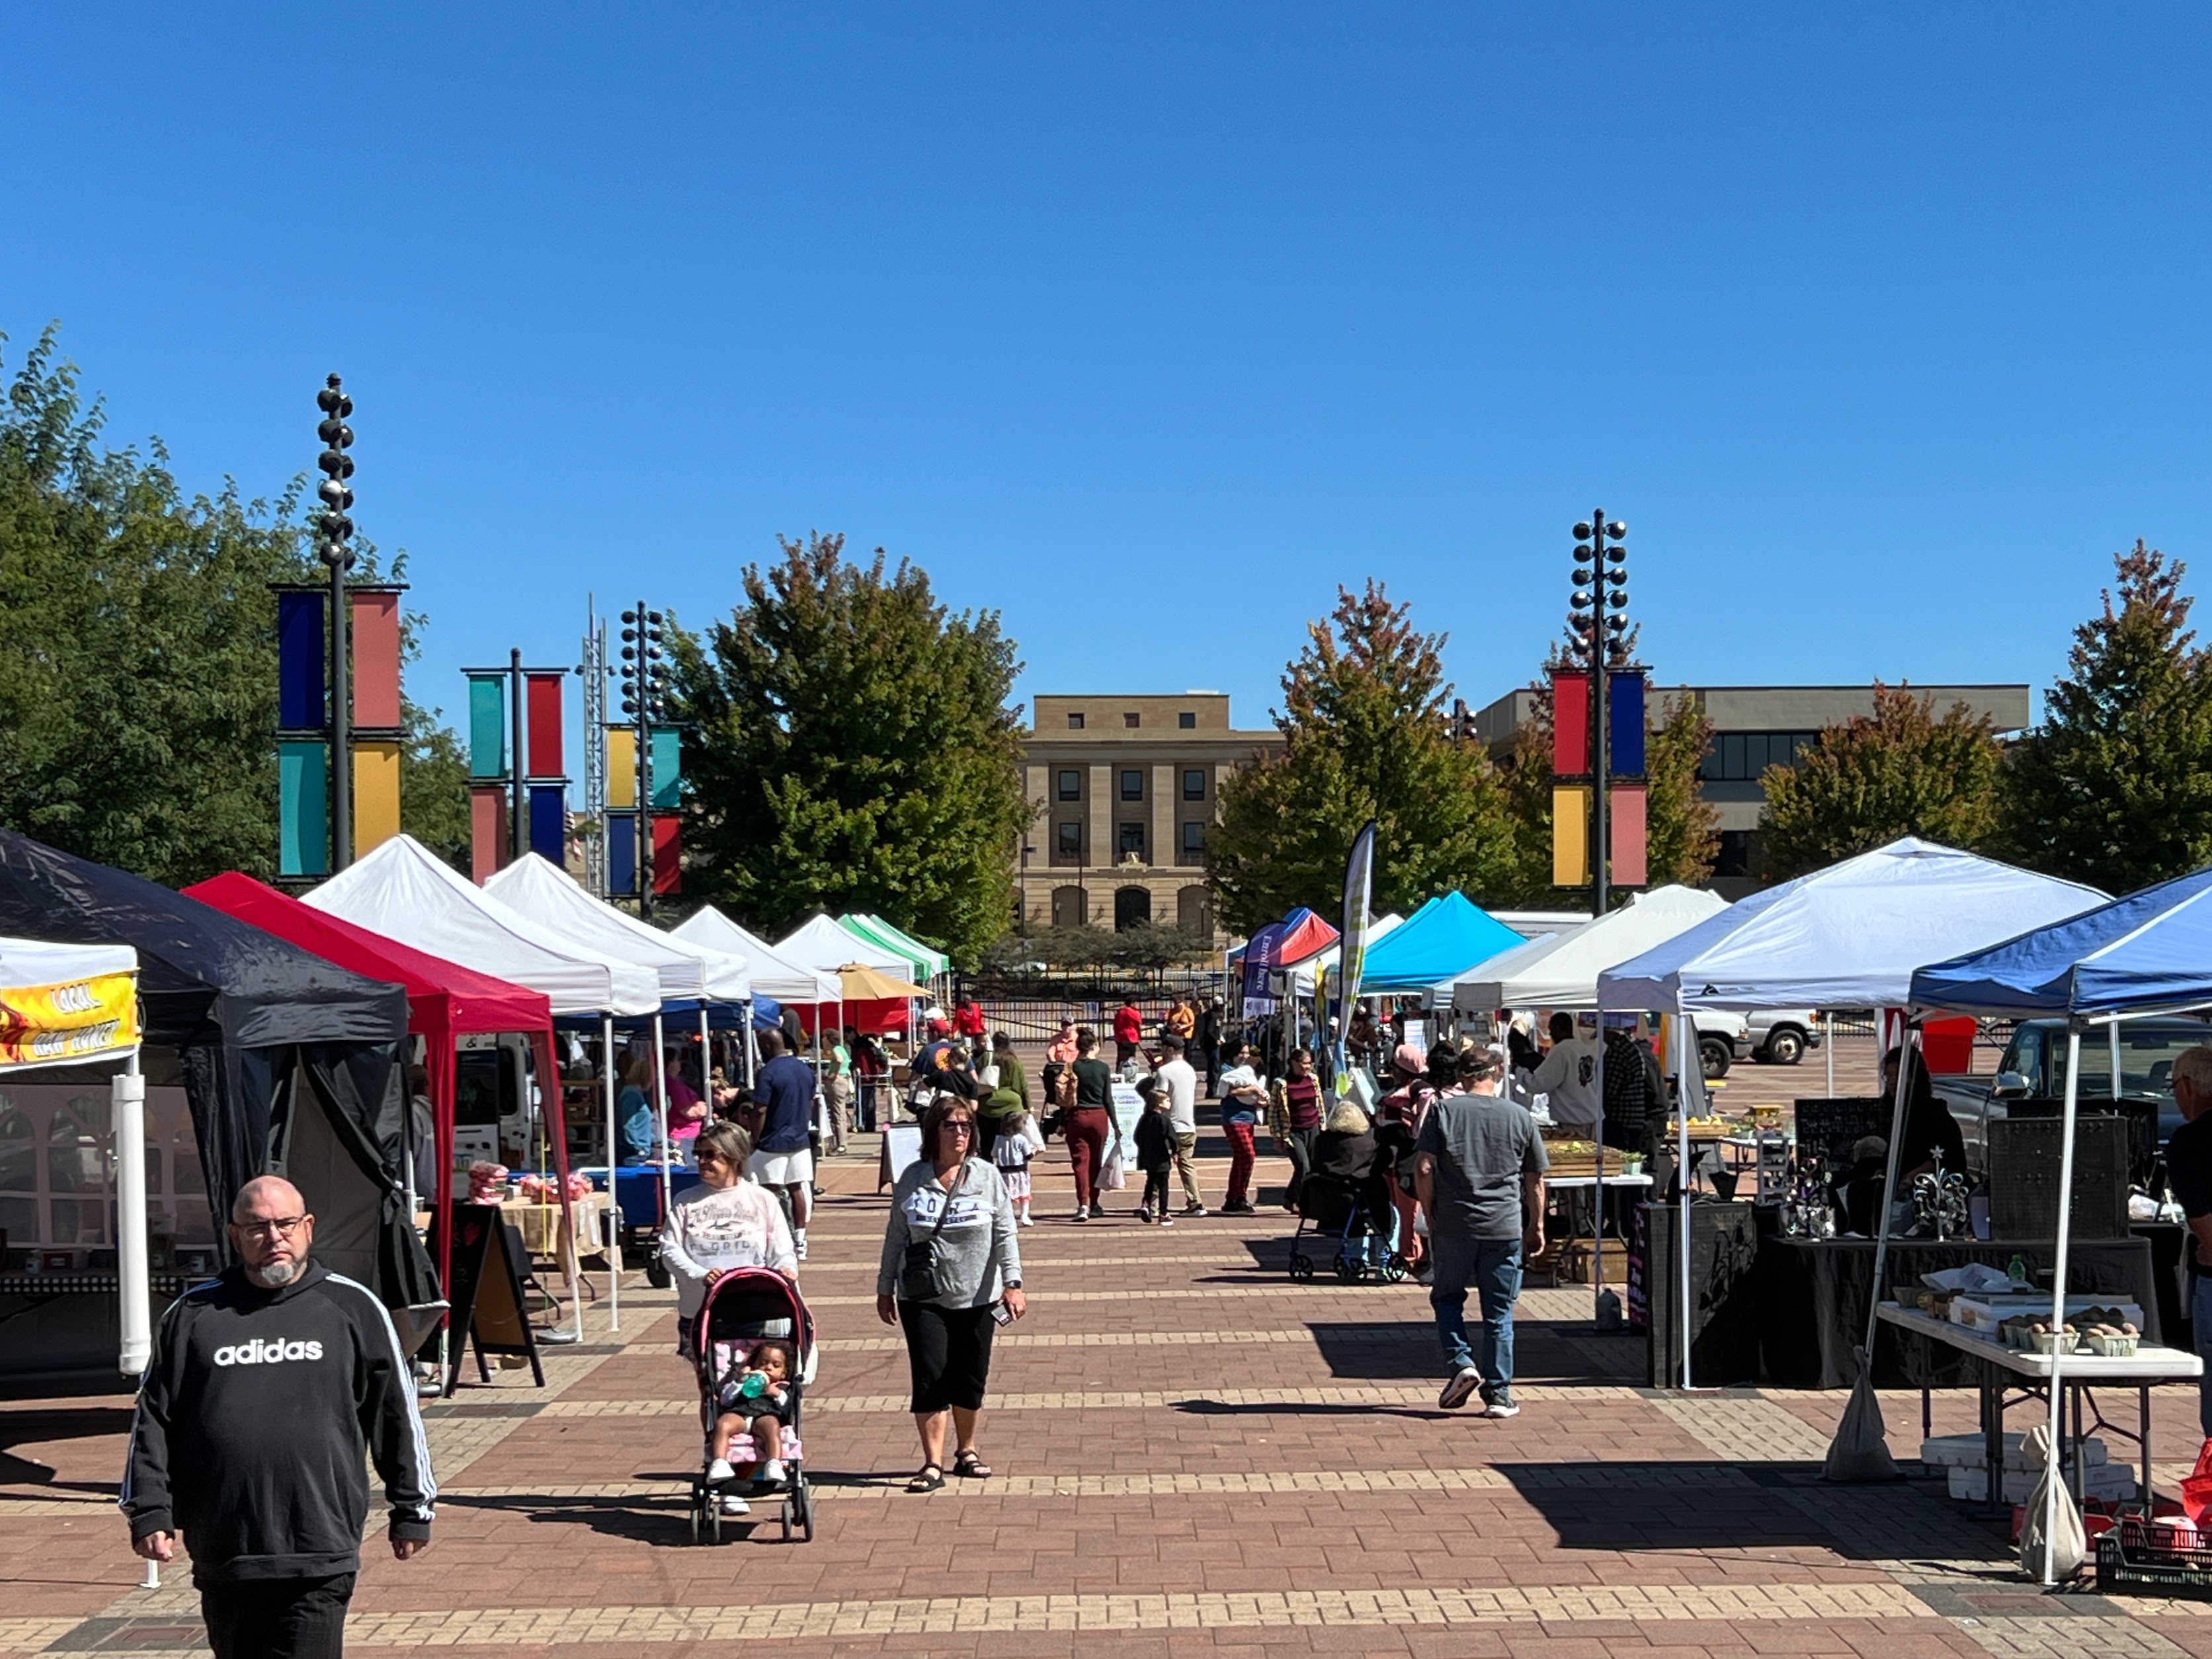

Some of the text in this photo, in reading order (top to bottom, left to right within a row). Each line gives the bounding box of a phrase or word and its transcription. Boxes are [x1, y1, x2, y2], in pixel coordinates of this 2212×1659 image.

[1259, 935, 1273, 967] Enroll
[1256, 967, 1268, 991] here
[50, 983, 104, 1014] LOCAL
[34, 1018, 120, 1057] RAW HONEY
[214, 1337, 323, 1366] adidas
